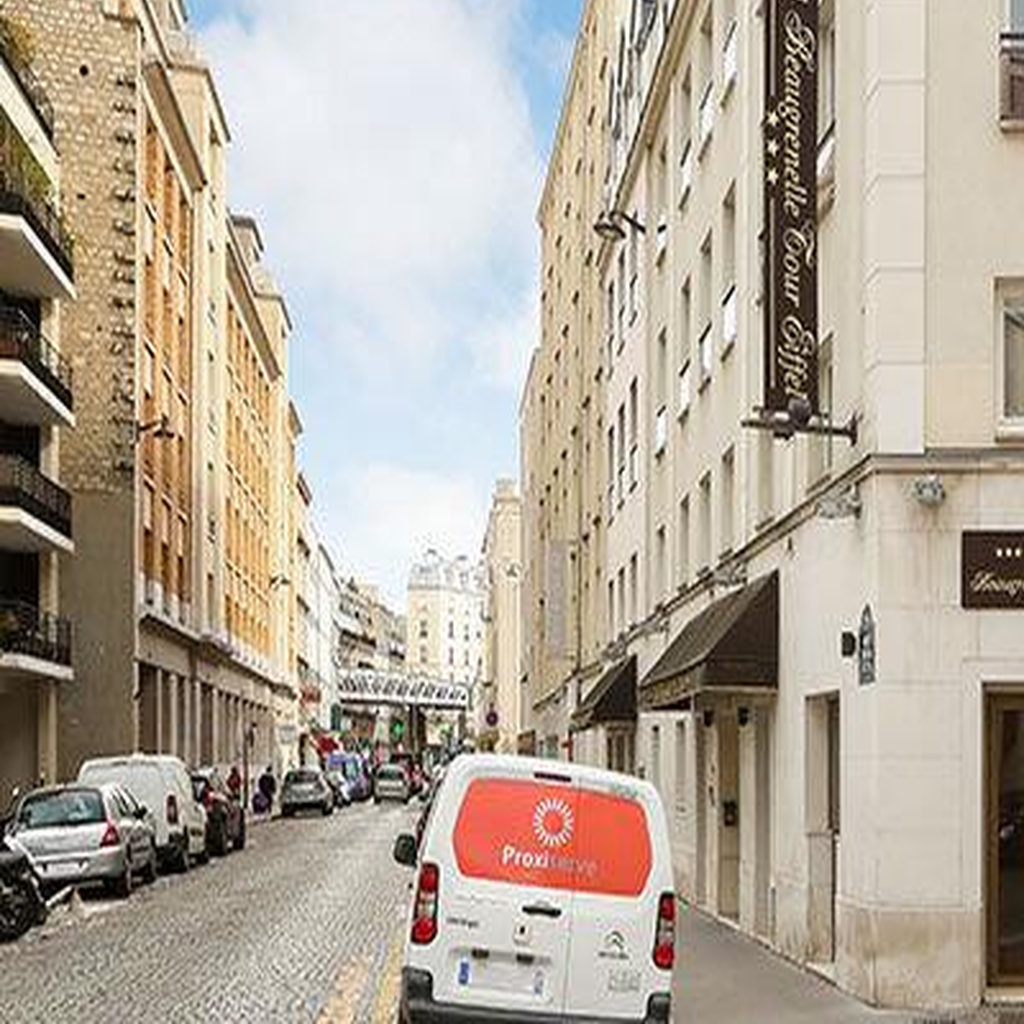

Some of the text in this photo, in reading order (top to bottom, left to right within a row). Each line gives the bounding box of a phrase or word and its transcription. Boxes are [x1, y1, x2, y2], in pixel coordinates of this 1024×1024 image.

[779, 12, 816, 217] Beaugrenelle
[781, 220, 816, 307] Tour
[778, 317, 816, 397] Eiffel
